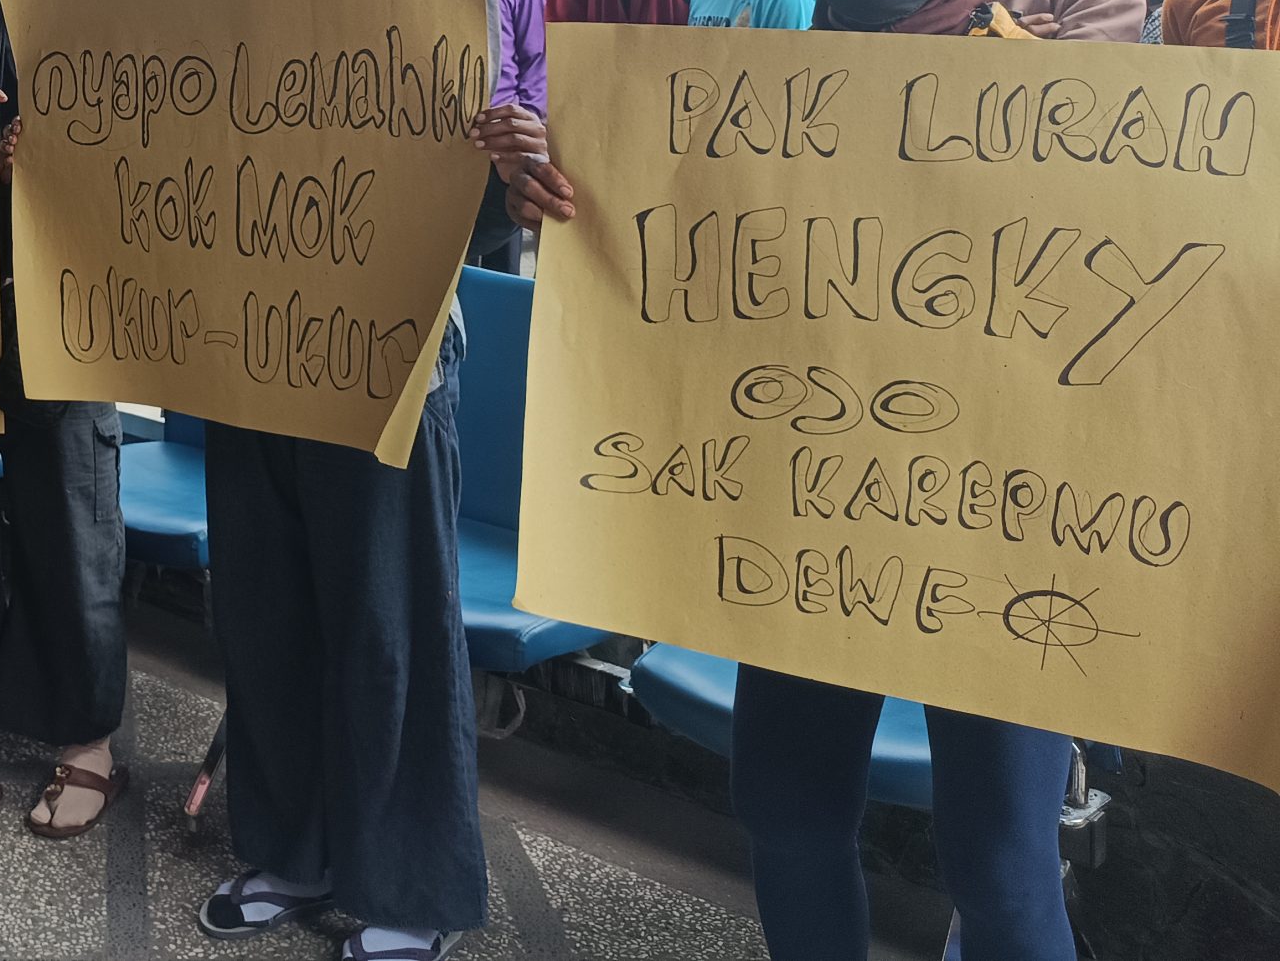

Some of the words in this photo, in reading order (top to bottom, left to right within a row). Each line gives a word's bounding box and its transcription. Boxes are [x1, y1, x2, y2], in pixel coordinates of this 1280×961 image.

[666, 66, 850, 159] PAK
[896, 72, 1257, 177] LURAH
[632, 203, 1227, 386] HENGKY
[579, 431, 751, 502] SAK
[789, 445, 1192, 568] KAREPMU
[714, 533, 977, 633] DEWE
